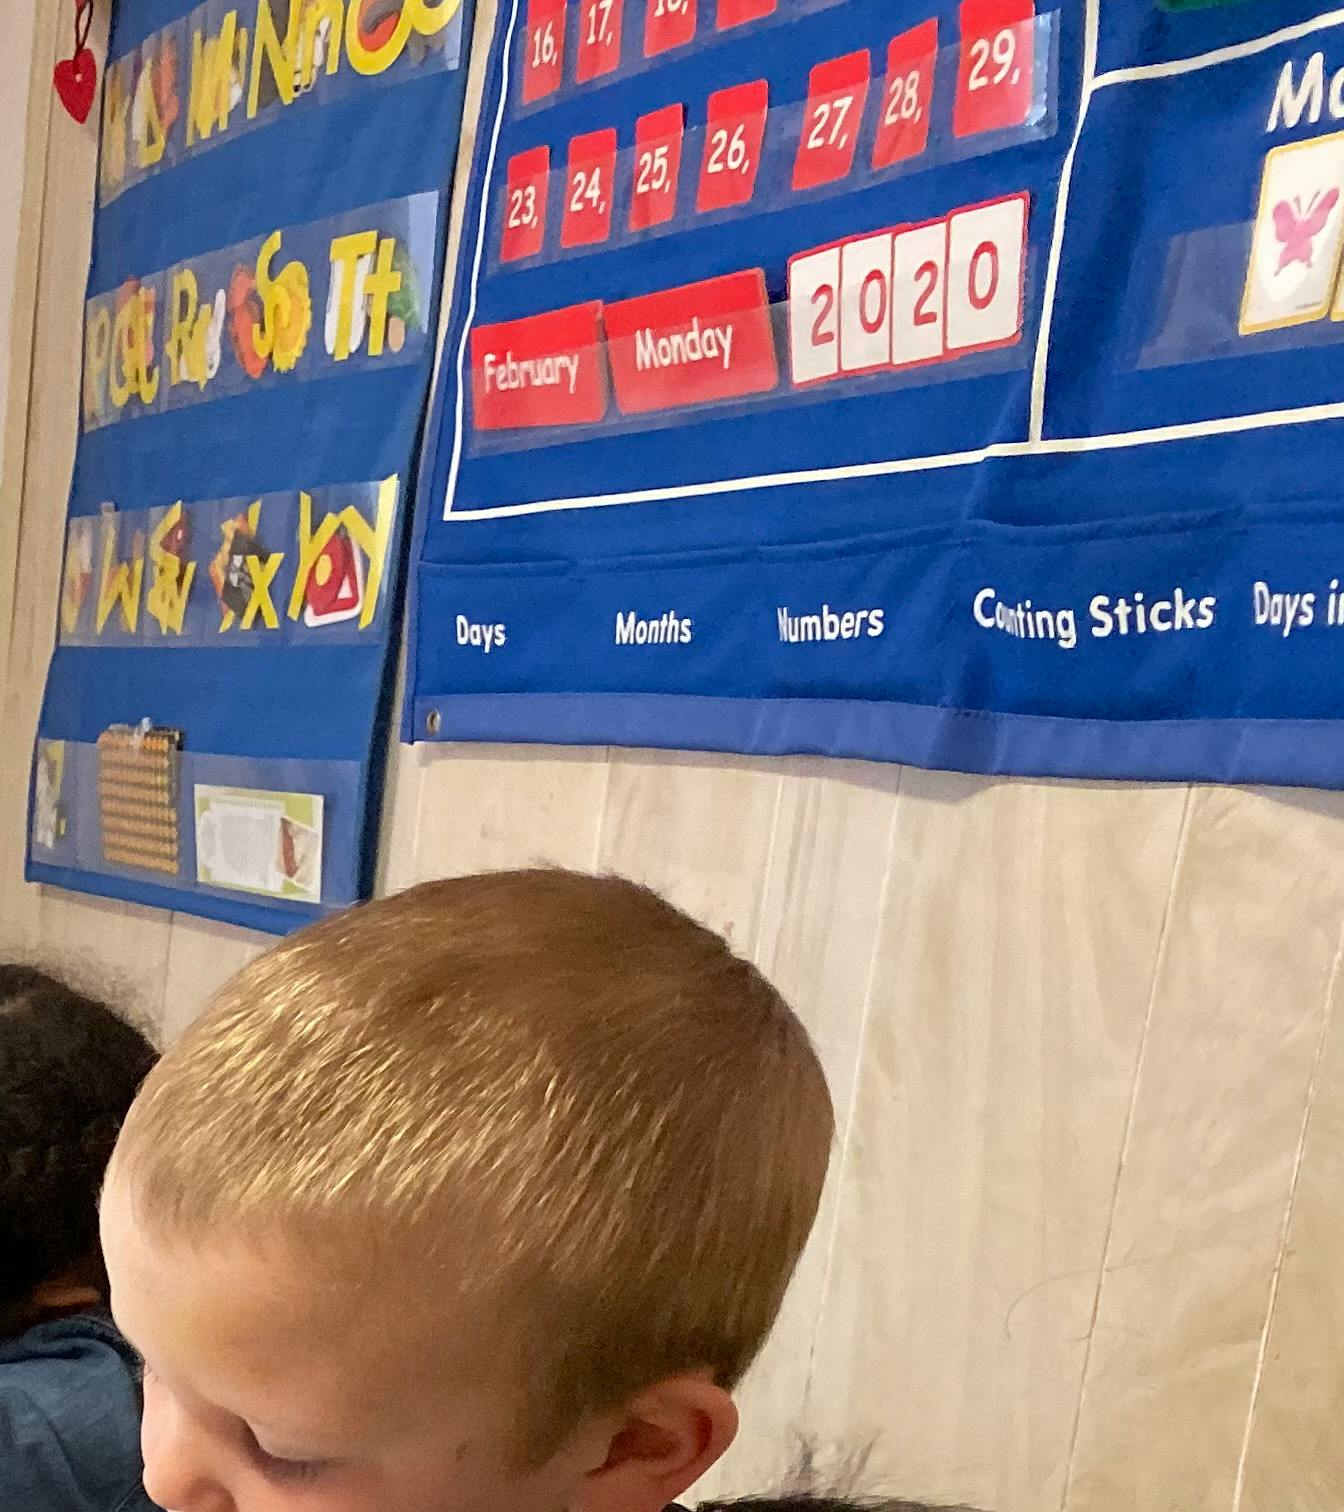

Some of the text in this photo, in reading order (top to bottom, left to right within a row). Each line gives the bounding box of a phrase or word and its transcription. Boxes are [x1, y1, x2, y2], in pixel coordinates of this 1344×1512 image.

[508, 29, 1020, 229] 23, 24, 25, 26, 27, 28, 29,
[483, 351, 579, 395] February
[635, 316, 733, 372] Monday
[456, 614, 506, 653] Days
[615, 611, 692, 646] Months
[777, 604, 885, 643] Numbers
[1089, 587, 1216, 637] Sticks
[1253, 580, 1316, 638] Days
